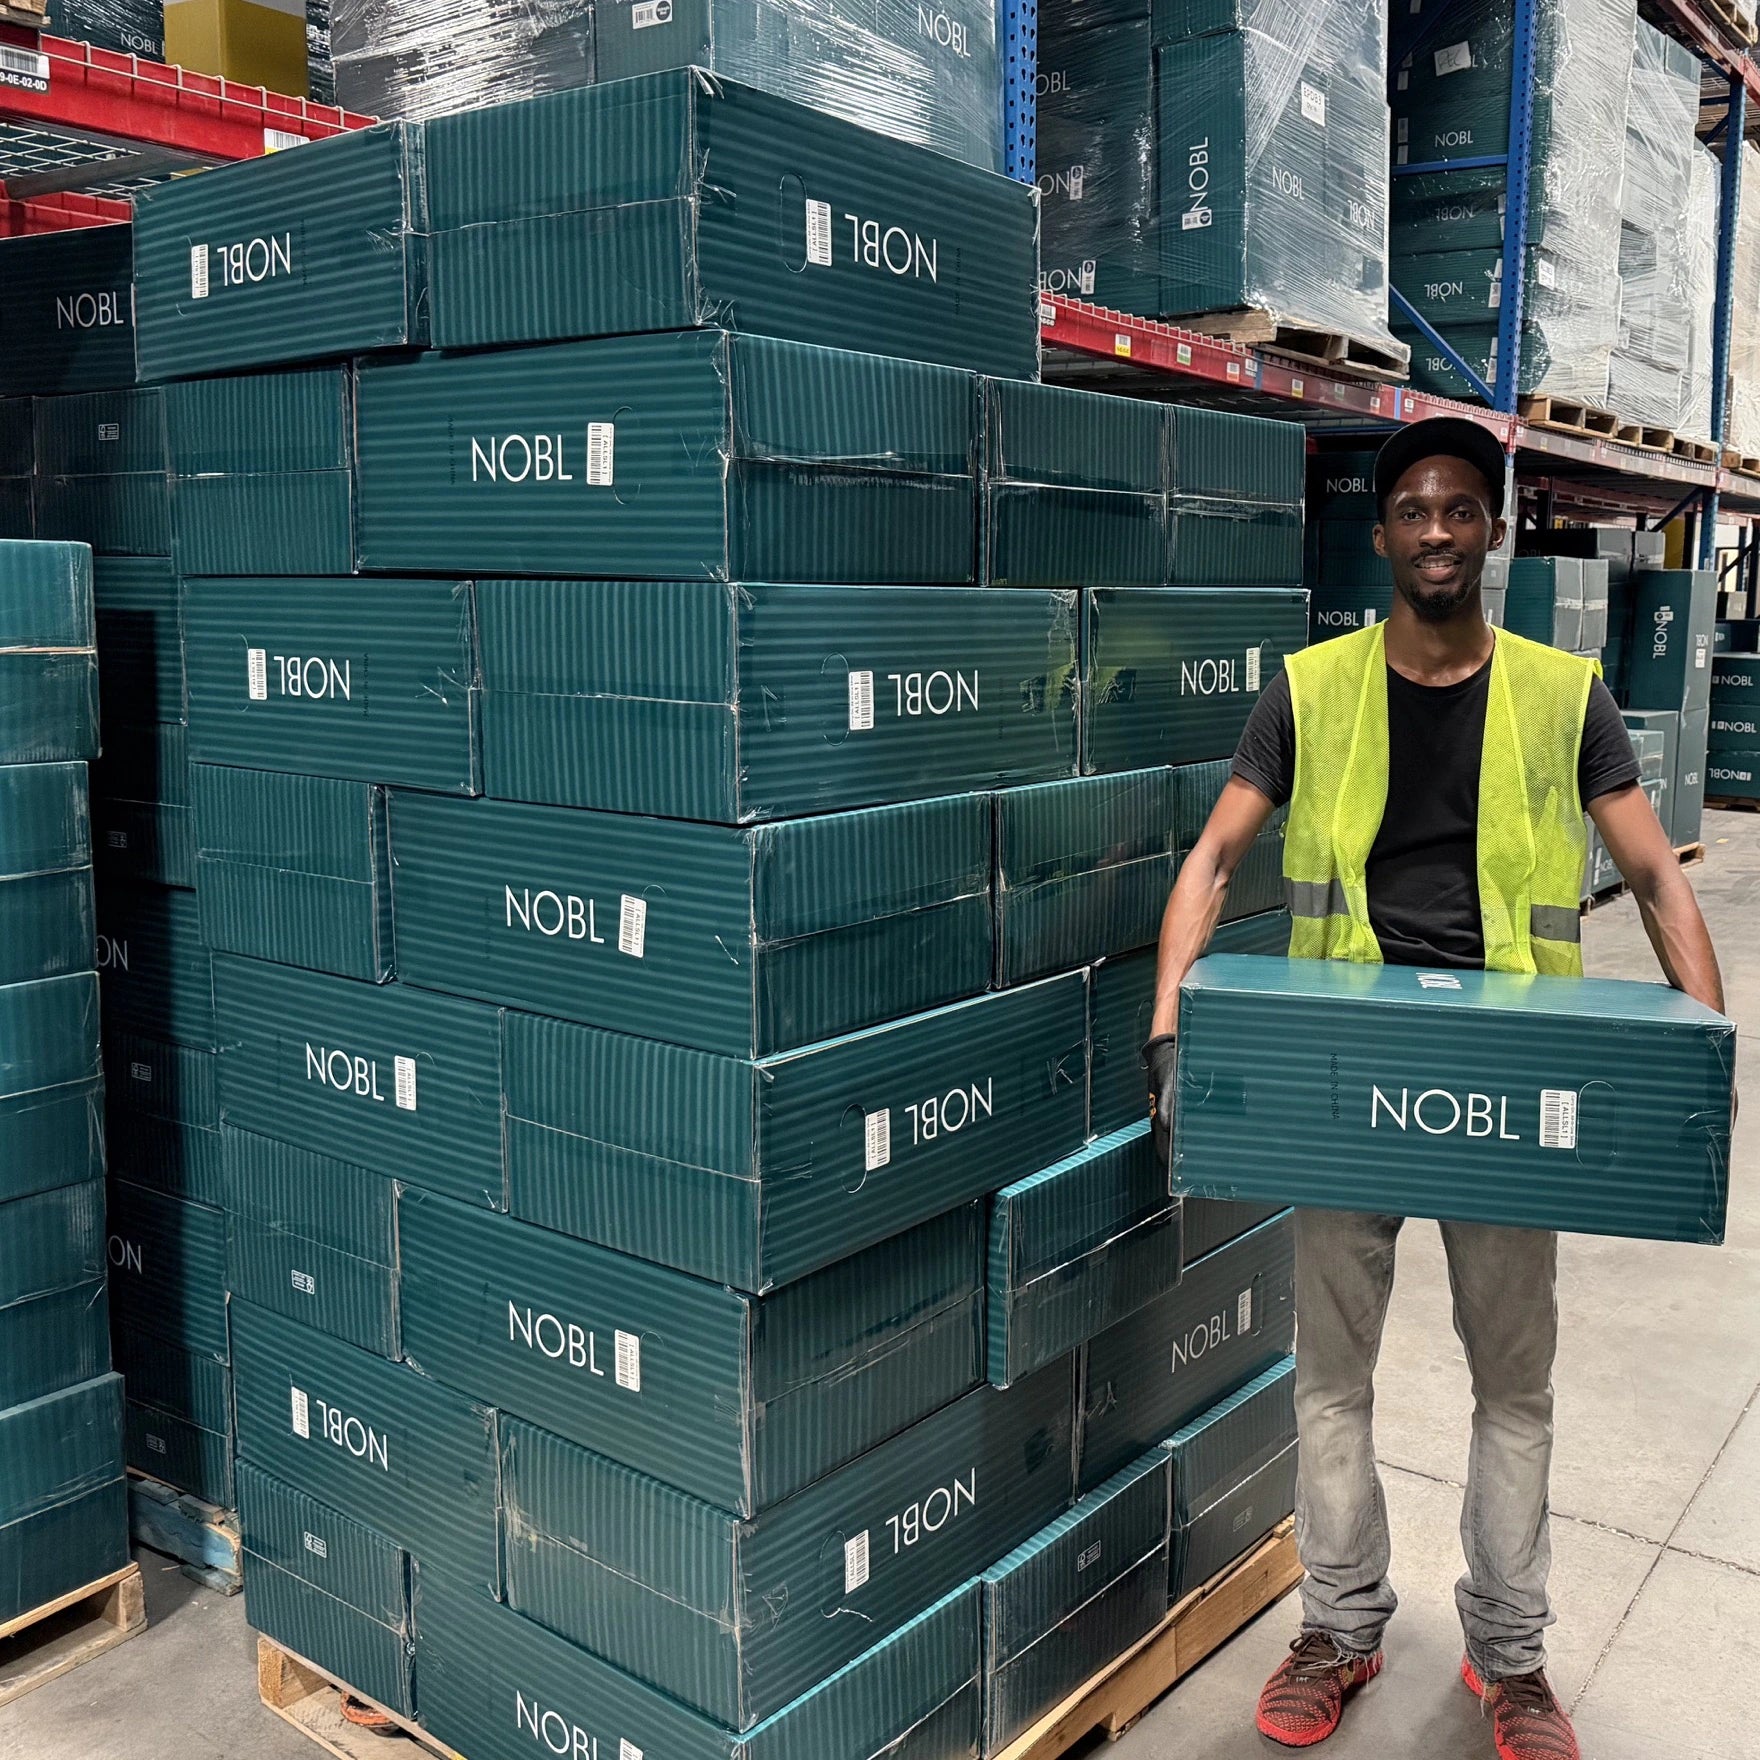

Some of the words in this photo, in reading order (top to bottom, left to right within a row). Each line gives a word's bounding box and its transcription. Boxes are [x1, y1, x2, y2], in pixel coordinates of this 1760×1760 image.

[120, 33, 158, 52] NOBL
[918, 3, 971, 57] NOBL
[1035, 70, 1071, 96] OBL
[1435, 130, 1473, 146] NOBL
[1189, 137, 1208, 211] NOBL
[1273, 166, 1304, 200] NOBL
[217, 233, 290, 286] NOBL
[845, 214, 936, 283] NOBL
[1424, 282, 1462, 297] NOBL
[57, 292, 124, 328] NOBL
[1426, 358, 1452, 371] OBL
[472, 435, 572, 482] NOBL
[1327, 478, 1368, 492] NOBL
[1318, 611, 1359, 626] NOBL
[1653, 620, 1669, 658] NOBL
[274, 656, 349, 700] NOBL
[888, 670, 978, 716] NOBL
[1181, 659, 1239, 695] NOBL
[1722, 675, 1753, 686] NOBL
[1725, 722, 1756, 733] NOBL
[1709, 768, 1740, 780] NOBL
[506, 885, 604, 943] NOBL
[306, 1043, 384, 1101] NOBL
[1330, 1053, 1338, 1076] MADE
[1331, 1082, 1339, 1090] IN
[905, 1077, 991, 1144] NOBL
[1331, 1093, 1340, 1119] CHINA
[1372, 1085, 1519, 1139] NOBL
[509, 1301, 604, 1376] NOBL
[1172, 1310, 1230, 1373] NOBL
[317, 1399, 388, 1471] NOBL
[886, 1468, 975, 1553] NOBL
